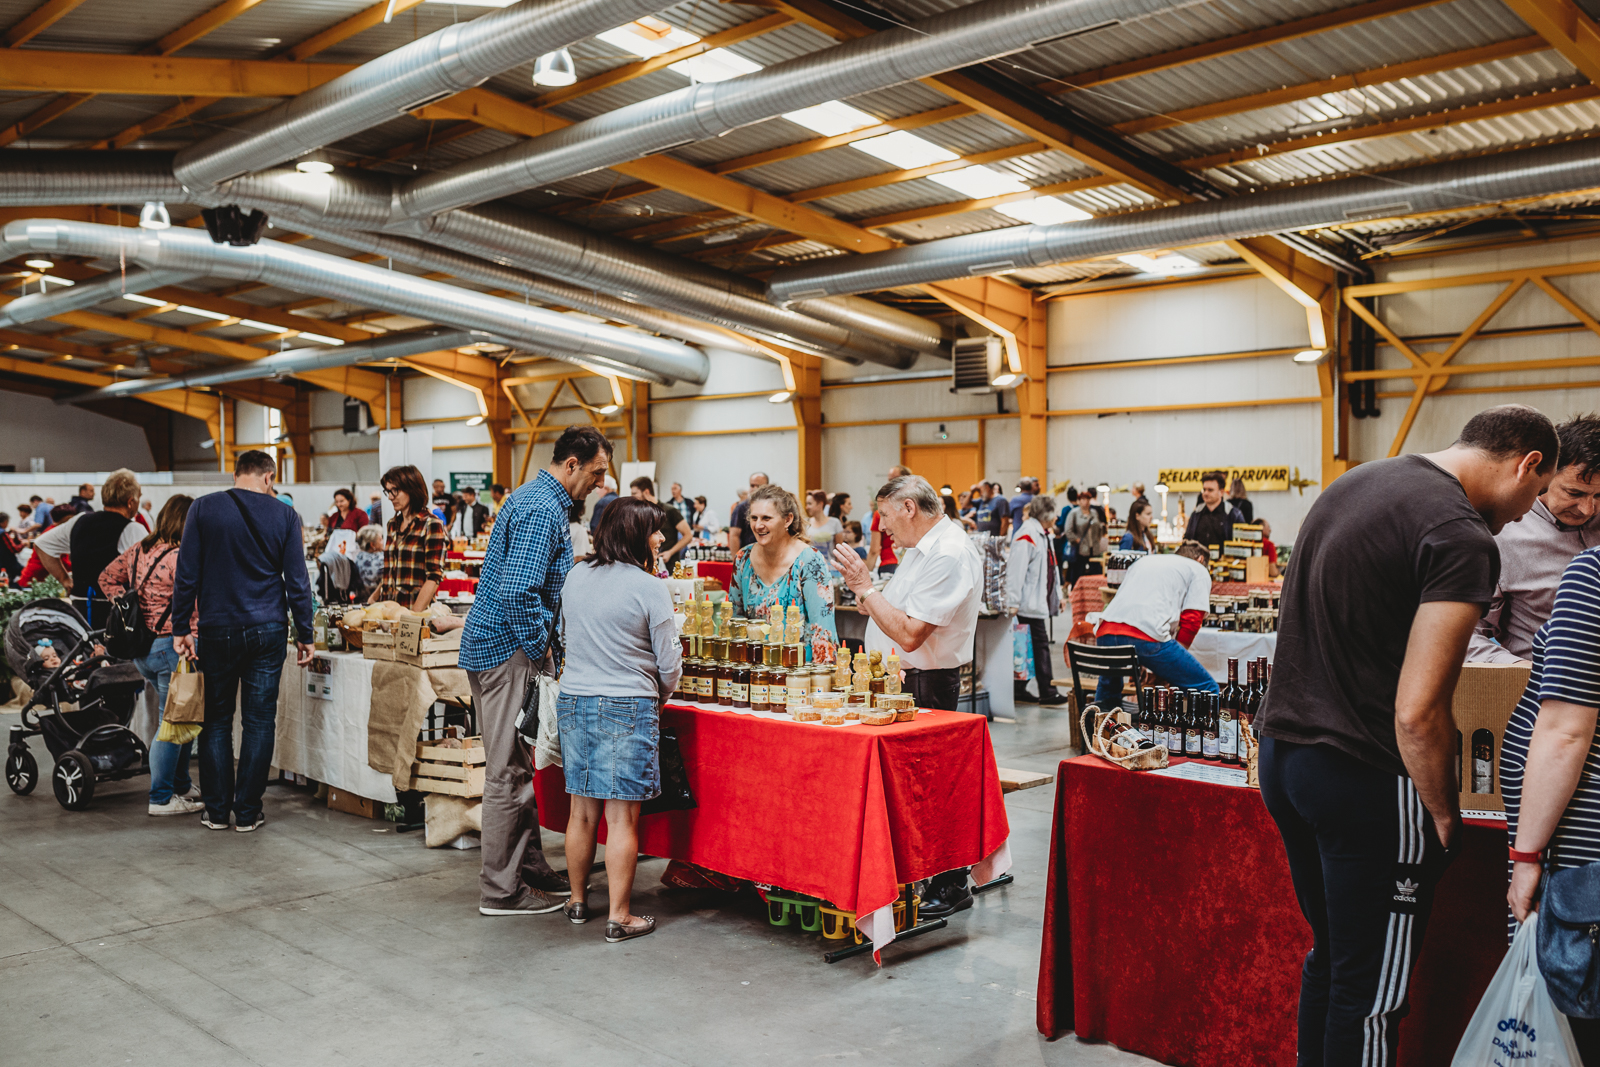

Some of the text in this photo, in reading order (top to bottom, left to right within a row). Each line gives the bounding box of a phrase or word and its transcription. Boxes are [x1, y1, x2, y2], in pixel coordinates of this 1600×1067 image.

[1160, 468, 1288, 483] PČELAR DARUVAR
[1393, 894, 1417, 903] adidas
